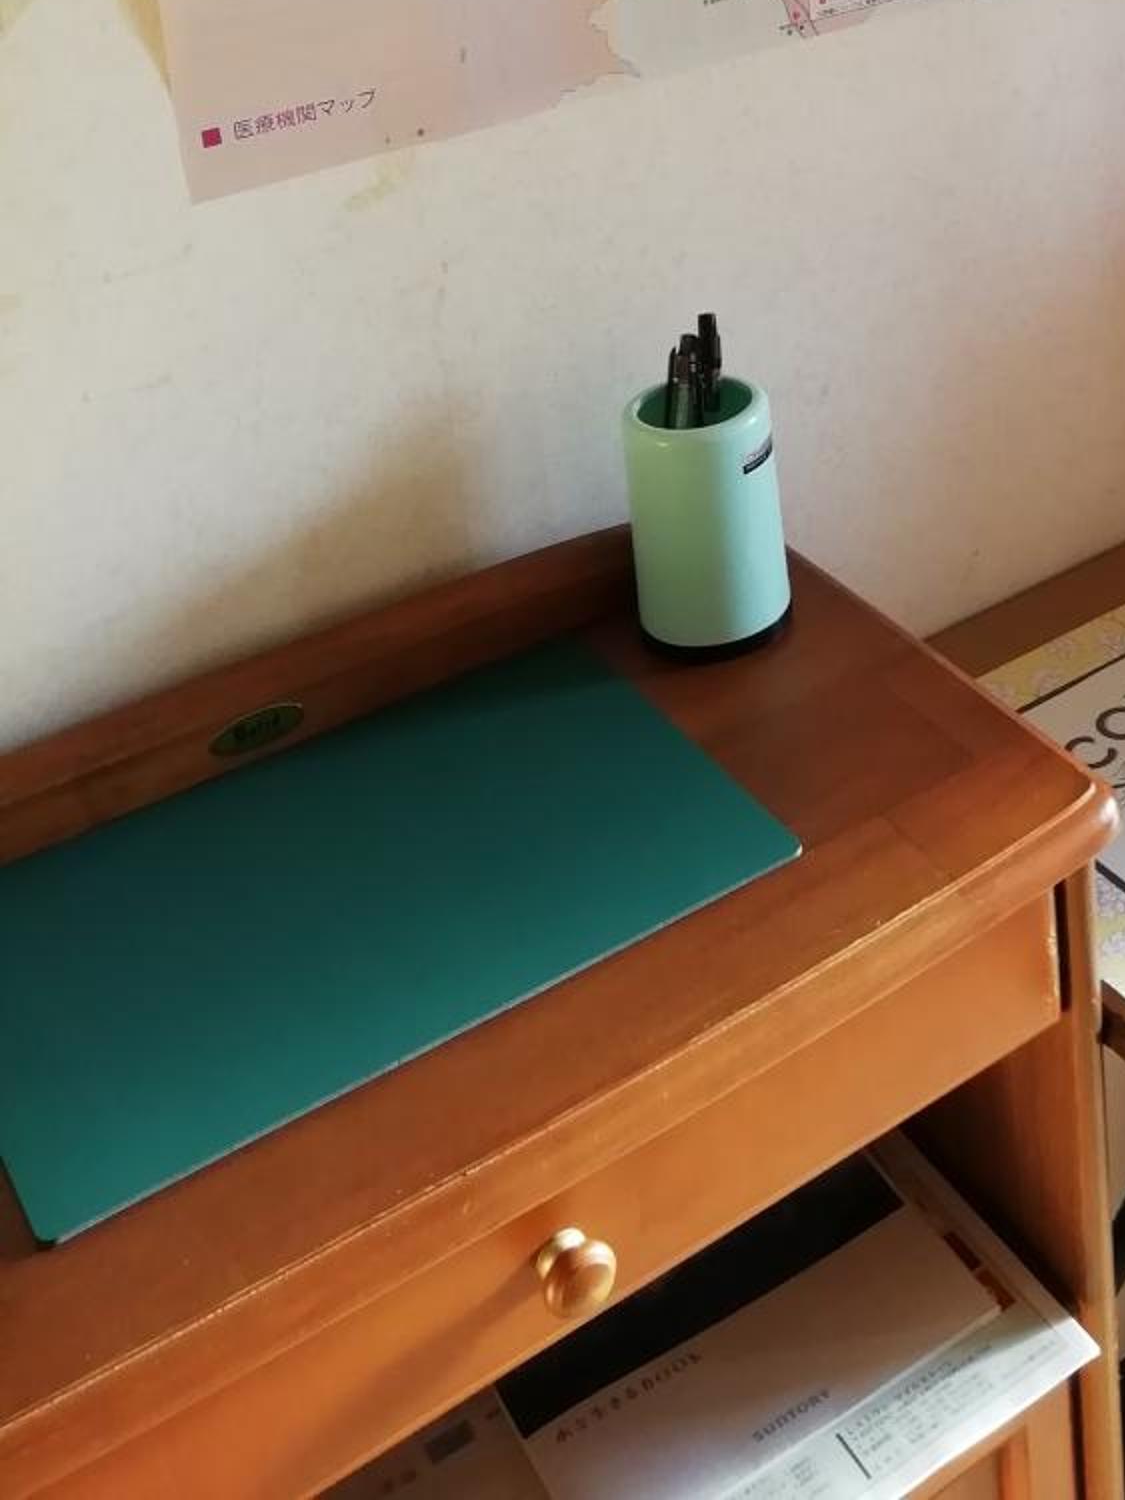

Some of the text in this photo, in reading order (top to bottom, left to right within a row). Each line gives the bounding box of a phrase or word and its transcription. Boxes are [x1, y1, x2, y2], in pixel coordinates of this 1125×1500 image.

[233, 89, 376, 140] 医療機関マップ
